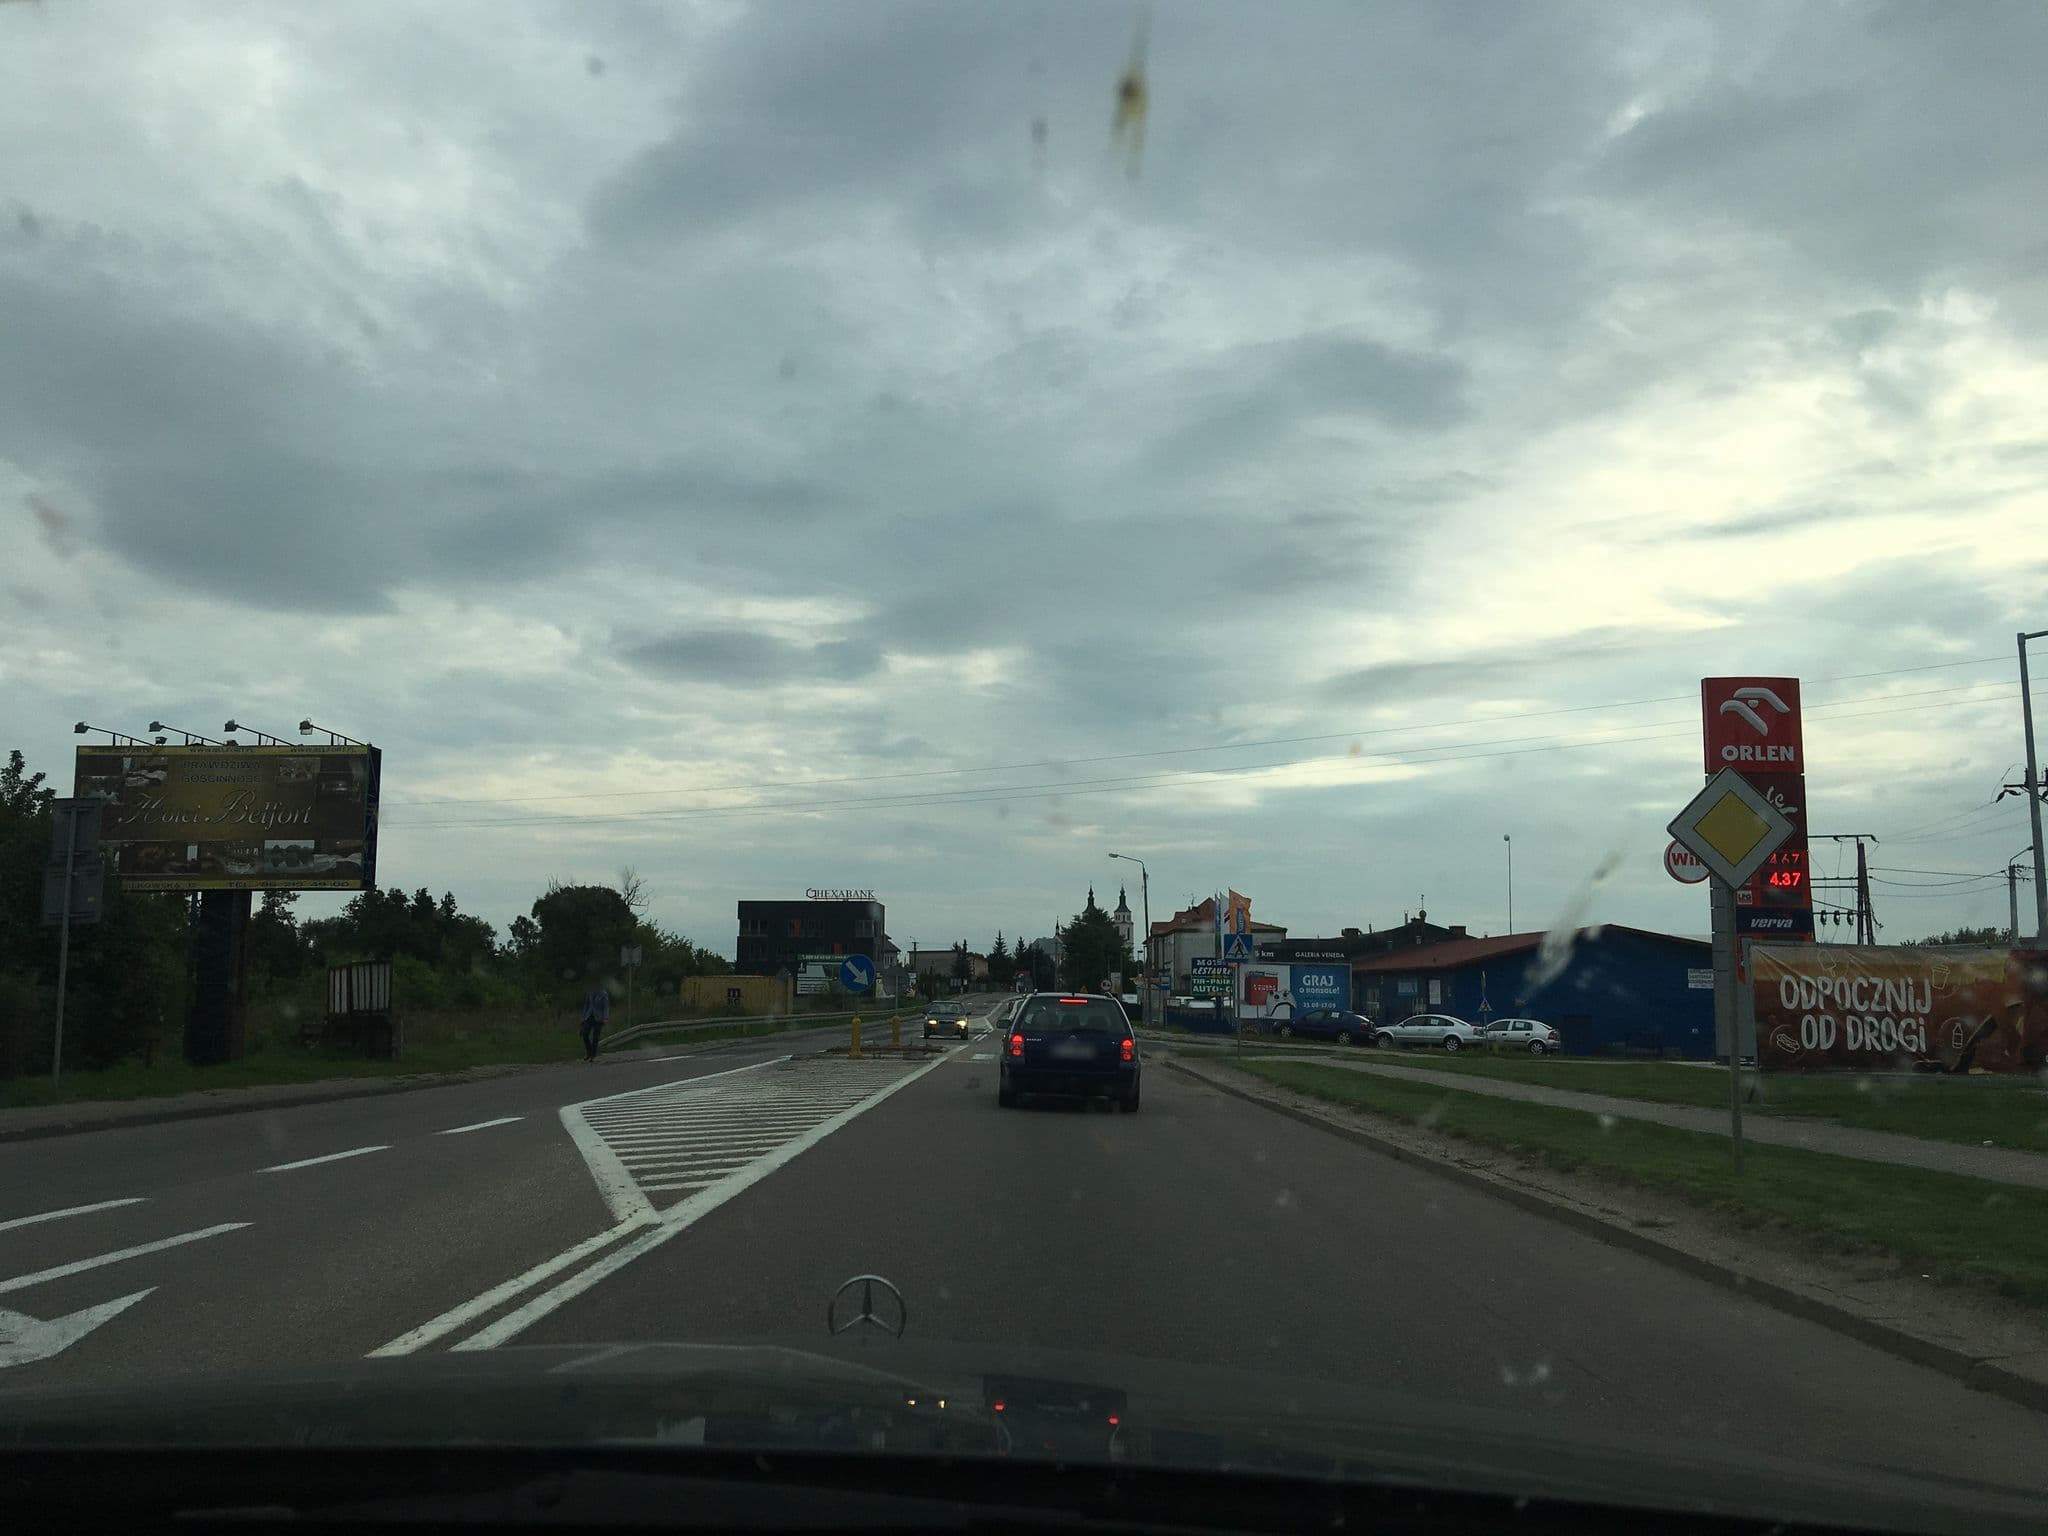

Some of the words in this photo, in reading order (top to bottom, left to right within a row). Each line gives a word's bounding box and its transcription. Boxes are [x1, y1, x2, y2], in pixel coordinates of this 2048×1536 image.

[1721, 745, 1795, 761] ORLEN
[204, 789, 312, 831] Belfort
[1769, 871, 1801, 887] 4.37
[1750, 917, 1793, 928] verva
[1261, 949, 1274, 958] km
[1302, 974, 1334, 987] GRAJ
[1800, 1013, 1837, 1051] OD
